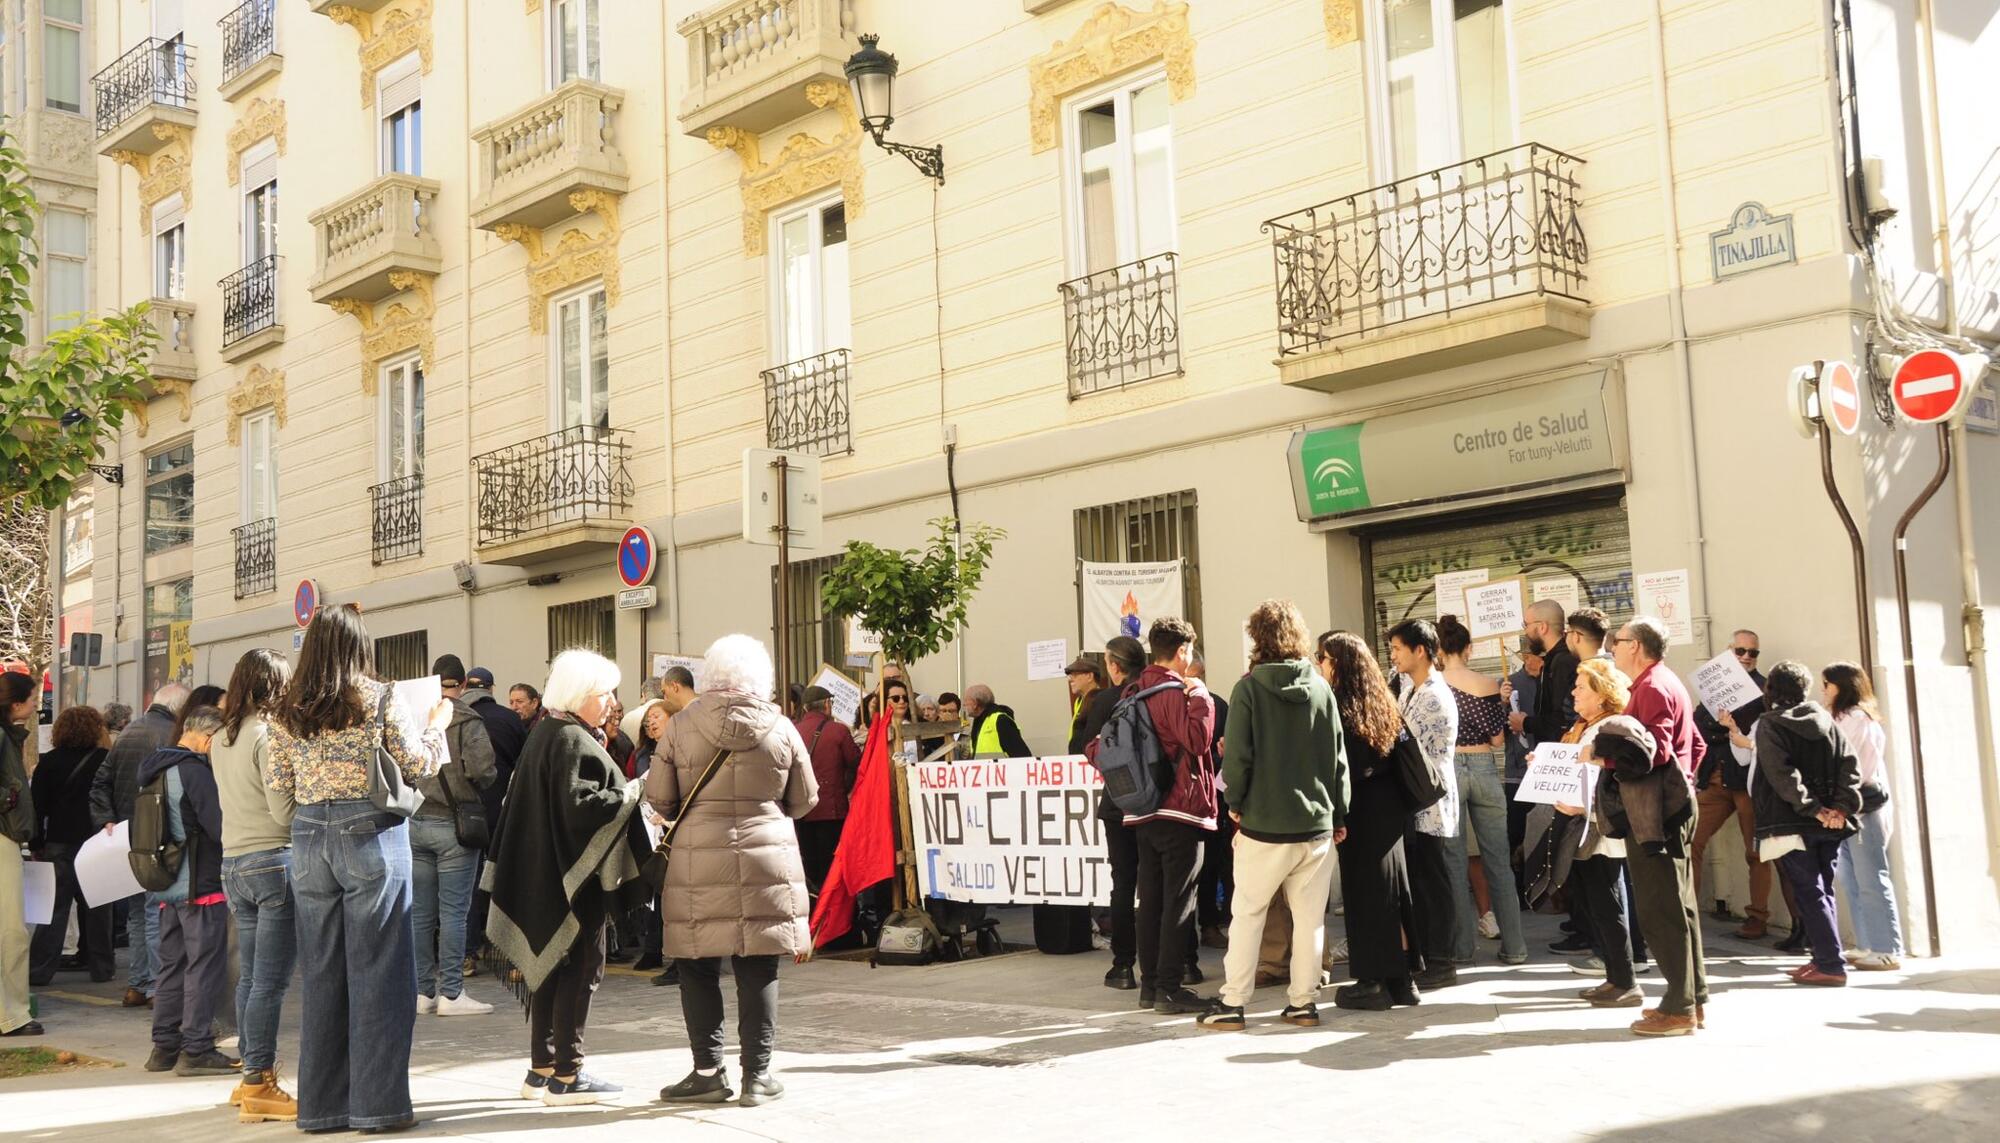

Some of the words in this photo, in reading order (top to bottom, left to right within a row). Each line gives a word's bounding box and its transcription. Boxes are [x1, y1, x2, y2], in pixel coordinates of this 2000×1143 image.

[1718, 233, 1786, 267] TINAJILLA
[1453, 428, 1507, 454] Centro
[1512, 421, 1533, 443] de
[1538, 408, 1589, 438] Salud
[1138, 568, 1158, 576] TURISMO
[1480, 588, 1508, 599] CIERRAN
[1489, 621, 1506, 630] TUYO
[1551, 750, 1567, 759] NO
[1533, 764, 1571, 776] CIERRE
[1533, 781, 1578, 793] VELUTTI
[921, 793, 964, 845] NO
[966, 805, 983, 828] AL
[947, 862, 995, 890] SALUD
[1003, 856, 1111, 897] VELUT
